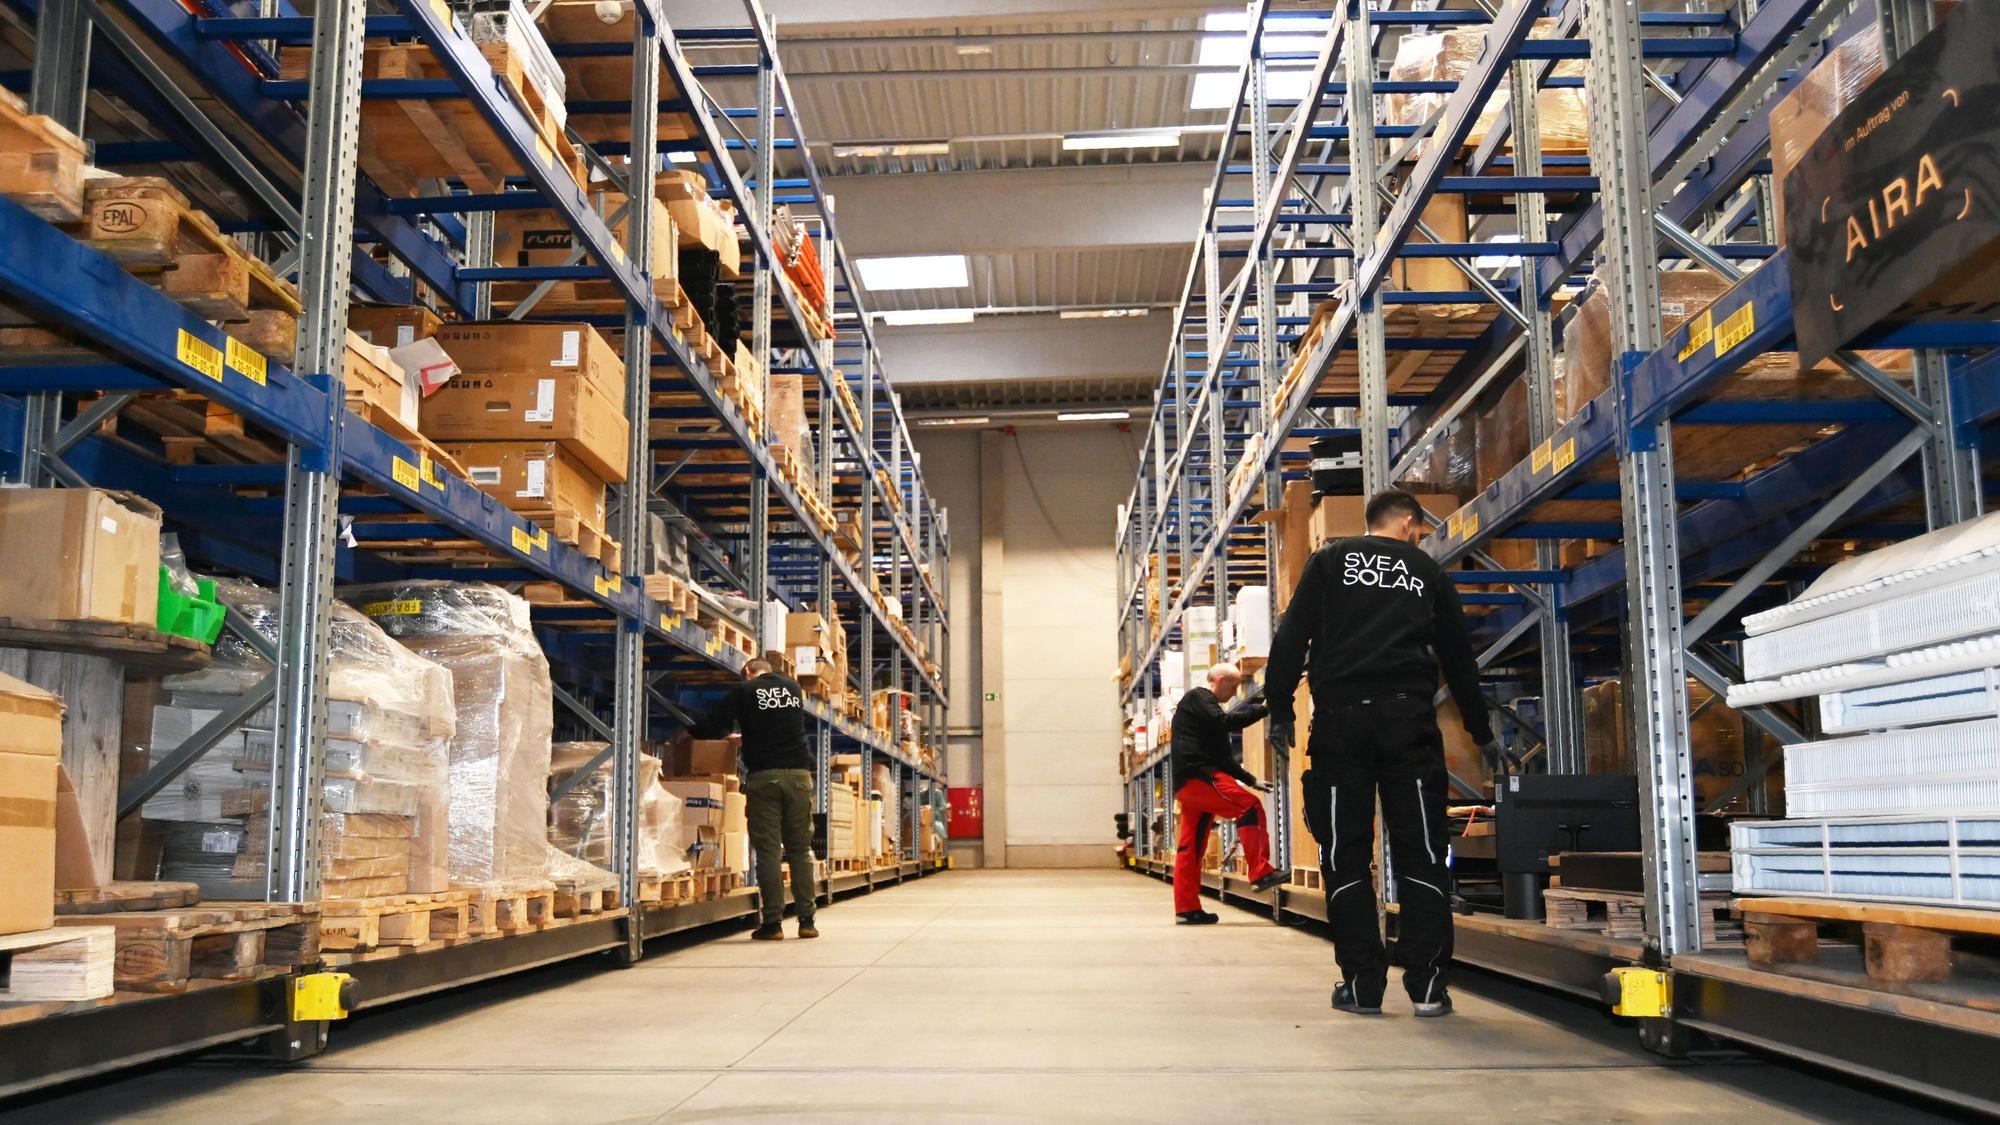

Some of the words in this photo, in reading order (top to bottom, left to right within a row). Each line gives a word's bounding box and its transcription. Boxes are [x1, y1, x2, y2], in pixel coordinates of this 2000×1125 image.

[1857, 106, 1890, 142] Auftrag
[1890, 90, 1909, 111] von
[103, 209, 138, 226] EPAL
[1846, 153, 1943, 263] AIRA
[527, 234, 572, 245] FLATF
[1344, 552, 1409, 575] SVEA
[1343, 568, 1424, 597] SOLAR
[756, 687, 792, 699] SVEA
[758, 697, 800, 710] SOLAR
